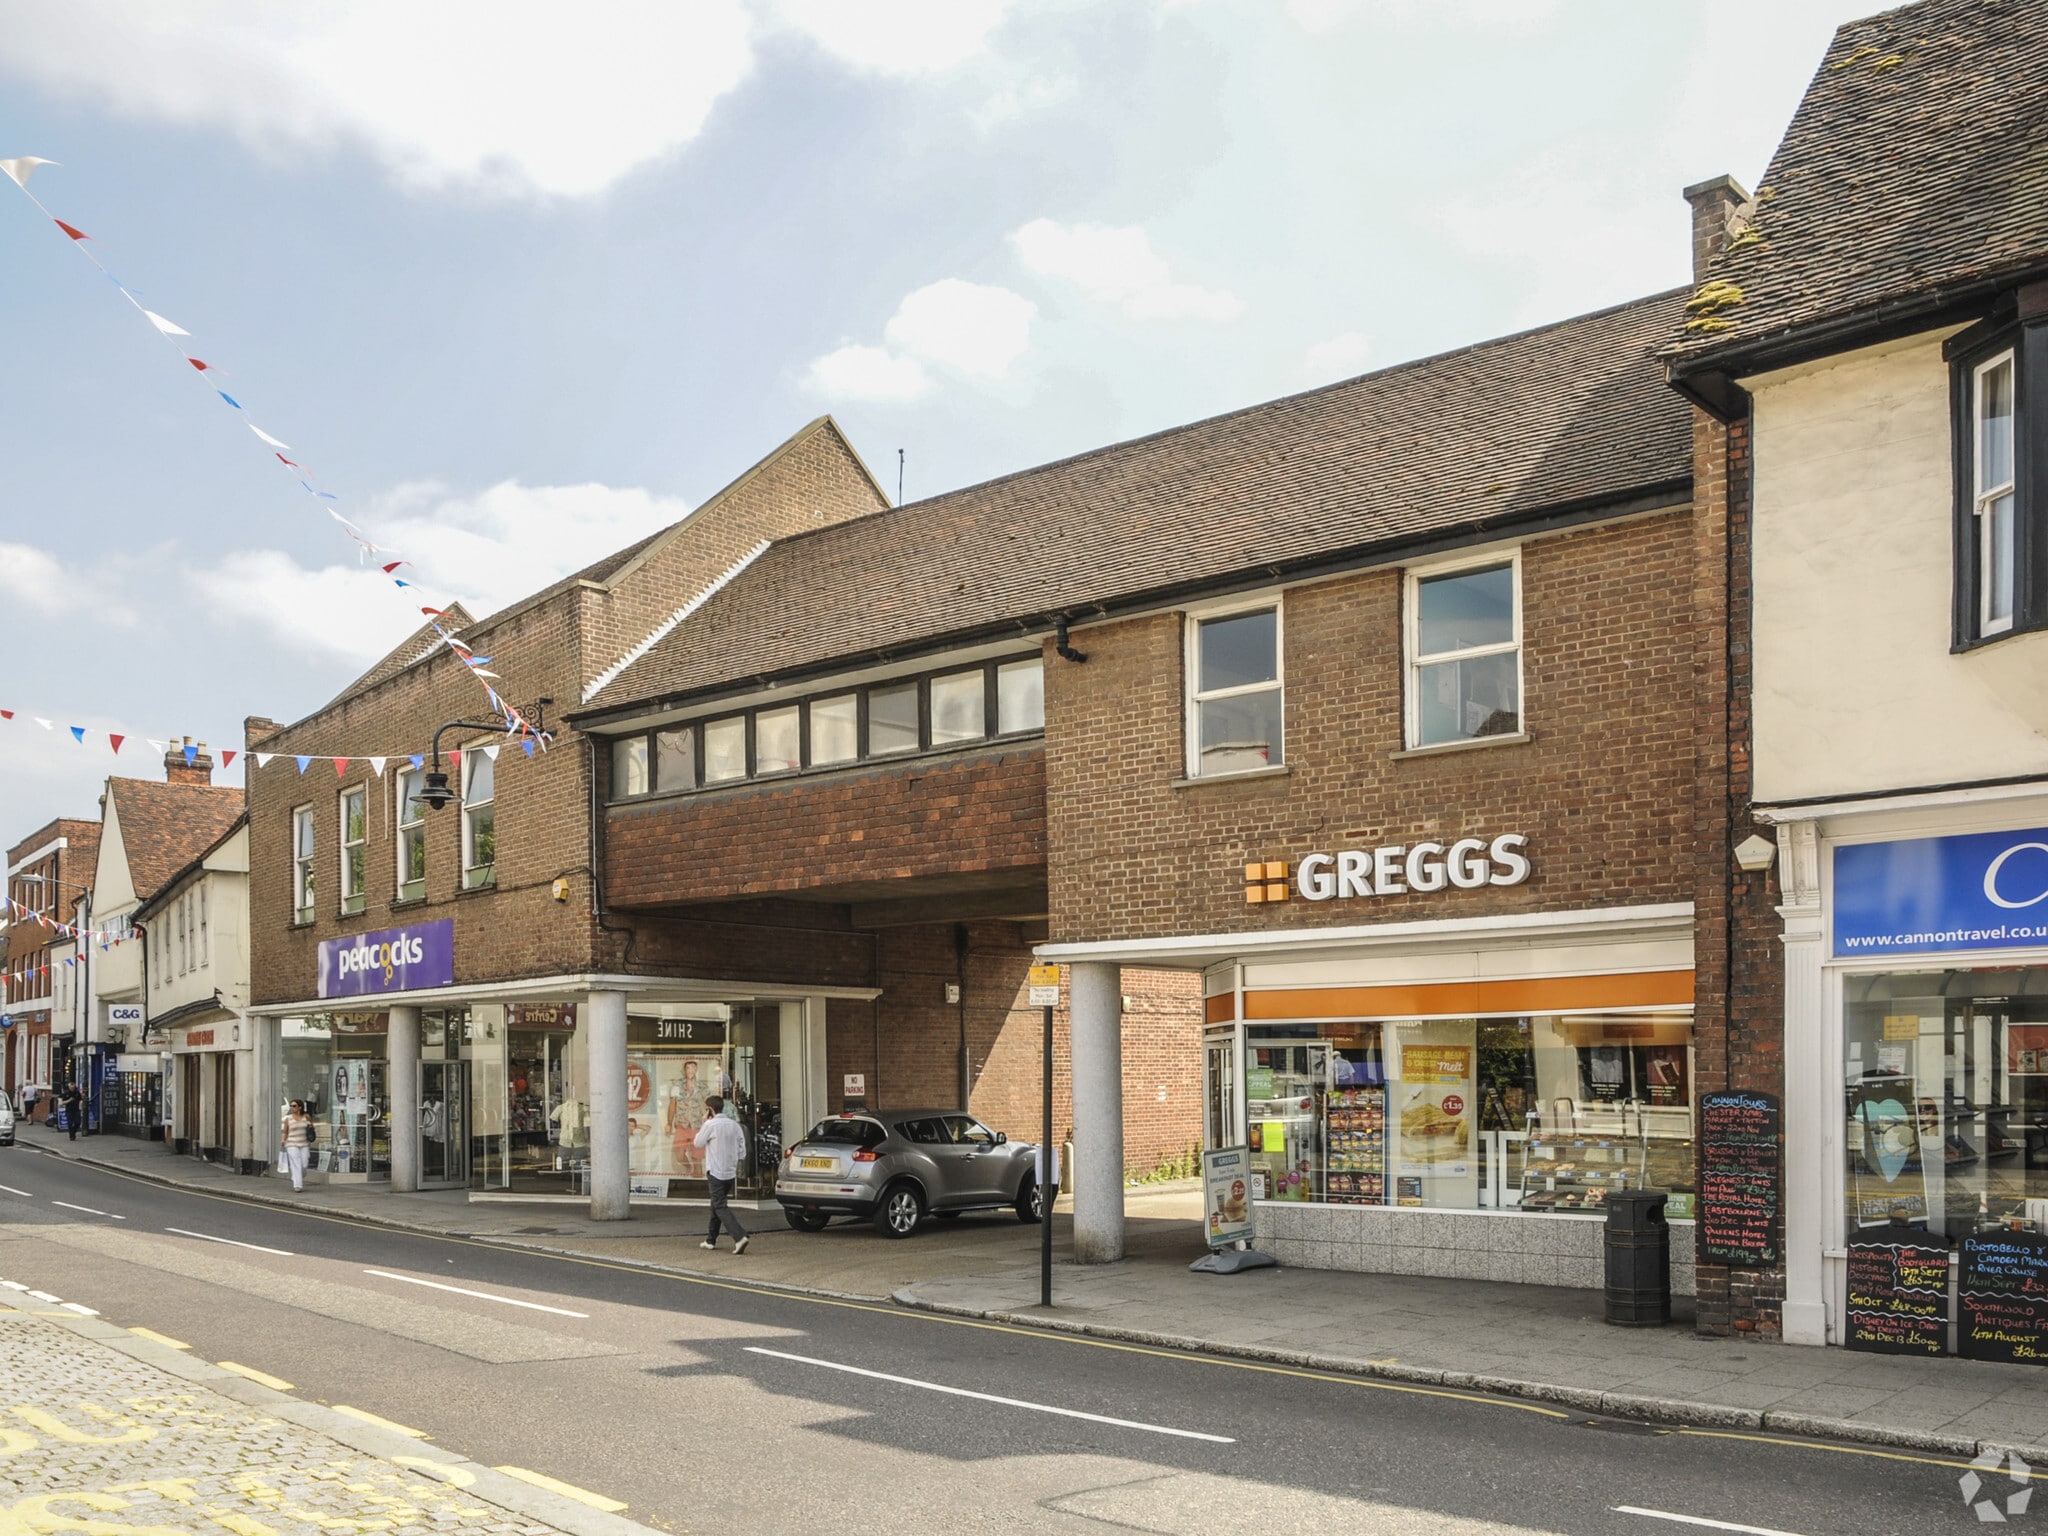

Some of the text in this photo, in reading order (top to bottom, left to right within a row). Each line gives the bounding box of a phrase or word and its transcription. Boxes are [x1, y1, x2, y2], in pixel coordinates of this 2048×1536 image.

[1297, 834, 1531, 901] GREGGS
[1845, 925, 2048, 947] www.cannontravel.co.u
[339, 933, 423, 981] peacocks
[112, 1009, 139, 1019] C&G
[1437, 1061, 1465, 1073] Melt
[851, 1076, 858, 1084] NO
[845, 1086, 864, 1094] PARKING
[1218, 1154, 1240, 1165] GREGGS
[1704, 1174, 1746, 1184] SKEGNESS
[1704, 1205, 1763, 1217] EASTBOURNE
[1704, 1225, 1740, 1236] QUEENS
[1898, 1248, 1917, 1258] THE
[1964, 1238, 2031, 1255] PORTOBELLO
[1897, 1256, 1949, 1268] BODYGUARD
[1977, 1252, 2018, 1265] CAMDEN
[1849, 1261, 1889, 1274] HISTORIC
[1977, 1263, 2003, 1274] RIVER
[2004, 1265, 2039, 1278] CRUISE
[1963, 1296, 2035, 1316] SOUTHWOLD
[1853, 1314, 1885, 1327] DISNEY
[1975, 1312, 2031, 1329] ANTIQUES
[1994, 1330, 2039, 1343] AUGUST
